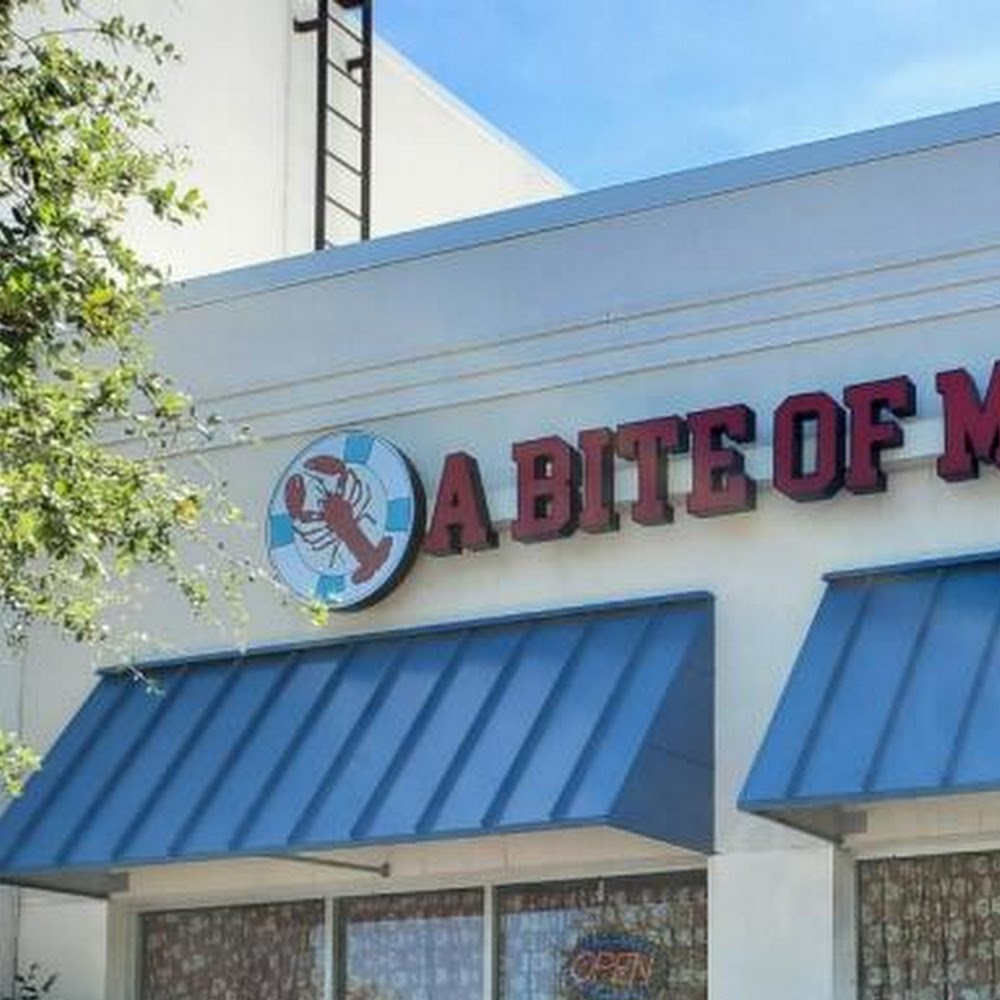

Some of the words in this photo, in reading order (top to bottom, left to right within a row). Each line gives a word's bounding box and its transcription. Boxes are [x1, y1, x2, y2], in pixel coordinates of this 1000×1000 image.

[423, 451, 499, 556] A
[511, 403, 757, 543] BITE
[772, 374, 917, 502] OF
[570, 950, 653, 988] OPEN
